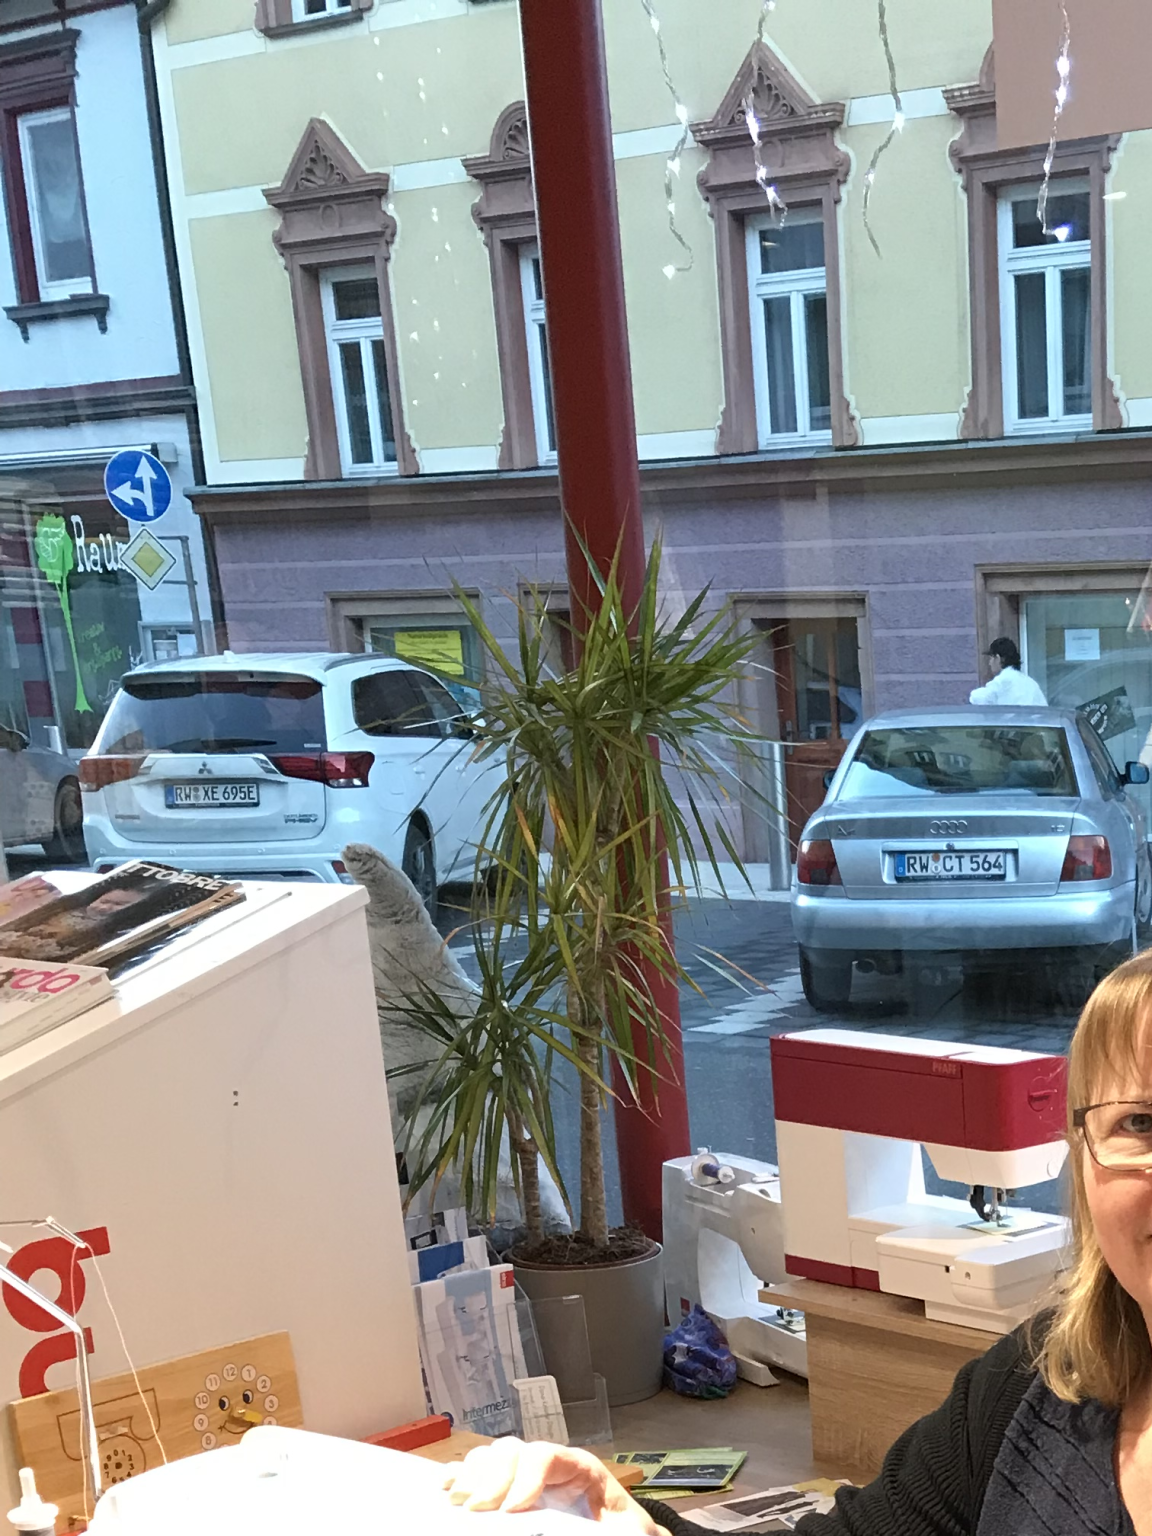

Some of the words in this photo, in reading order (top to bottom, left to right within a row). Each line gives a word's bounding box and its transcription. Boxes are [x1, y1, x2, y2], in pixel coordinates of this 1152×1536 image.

[175, 786, 192, 801] RW
[202, 786, 220, 801] XE
[222, 785, 256, 801] 695E
[907, 855, 931, 874] RW
[942, 856, 965, 873] CT
[970, 854, 1003, 873] 564
[462, 1399, 517, 1421] Intermez
